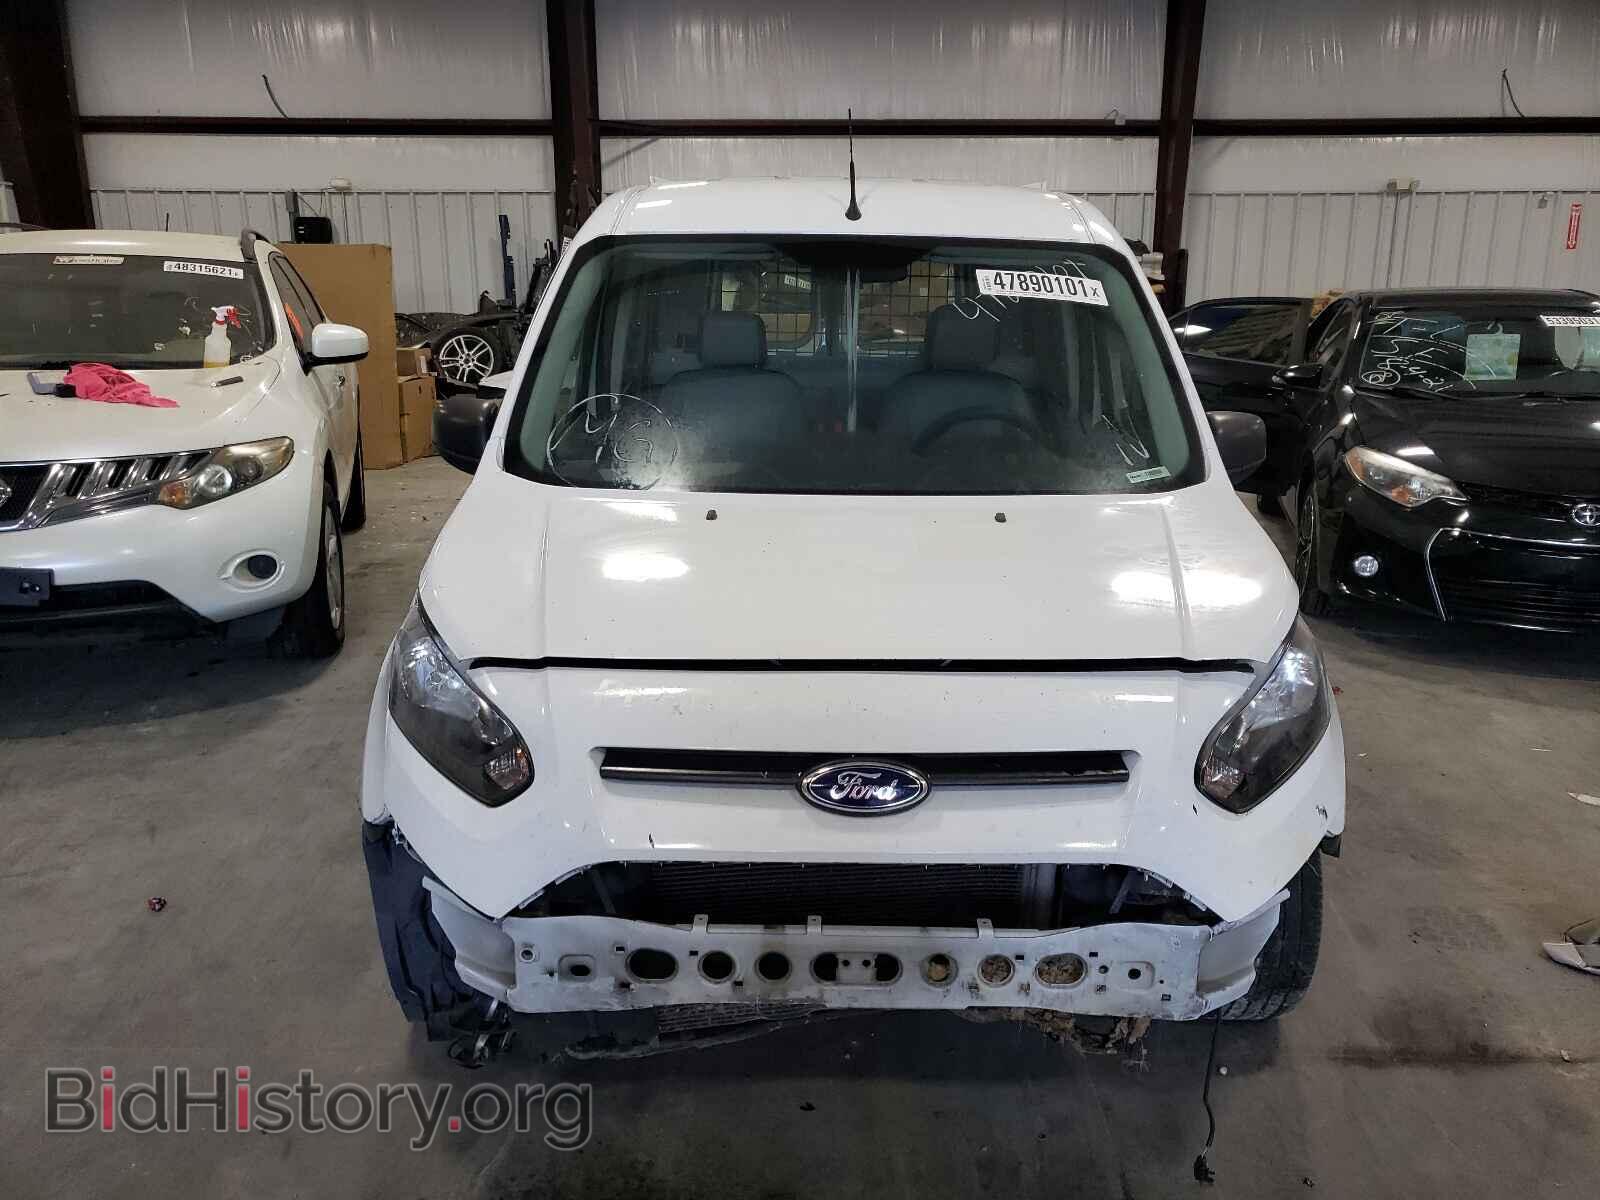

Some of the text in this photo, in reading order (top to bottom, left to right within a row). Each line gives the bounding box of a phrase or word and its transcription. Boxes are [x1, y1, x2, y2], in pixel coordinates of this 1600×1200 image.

[174, 263, 232, 276] 48315621
[993, 271, 1088, 297] 47890101
[829, 770, 899, 801] Ford
